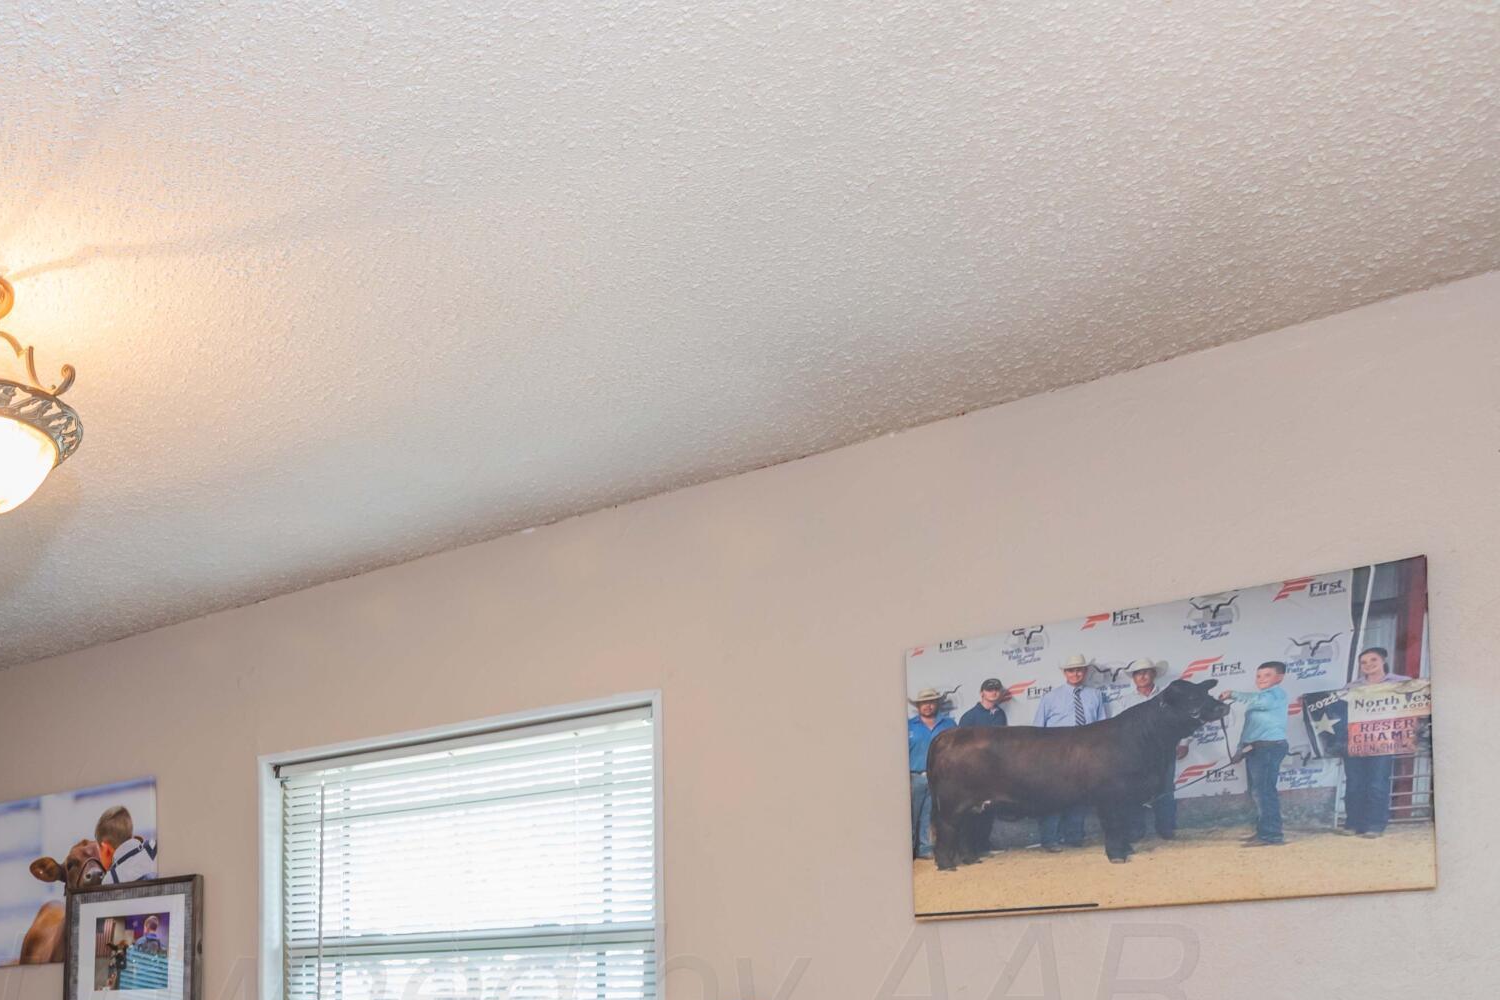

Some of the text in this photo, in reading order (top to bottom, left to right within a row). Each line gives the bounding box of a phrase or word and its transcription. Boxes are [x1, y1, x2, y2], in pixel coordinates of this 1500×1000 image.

[1310, 579, 1342, 594] First
[1112, 611, 1140, 622] First
[1211, 661, 1242, 674] First
[1355, 696, 1400, 710] North
[1360, 719, 1414, 733] RESER
